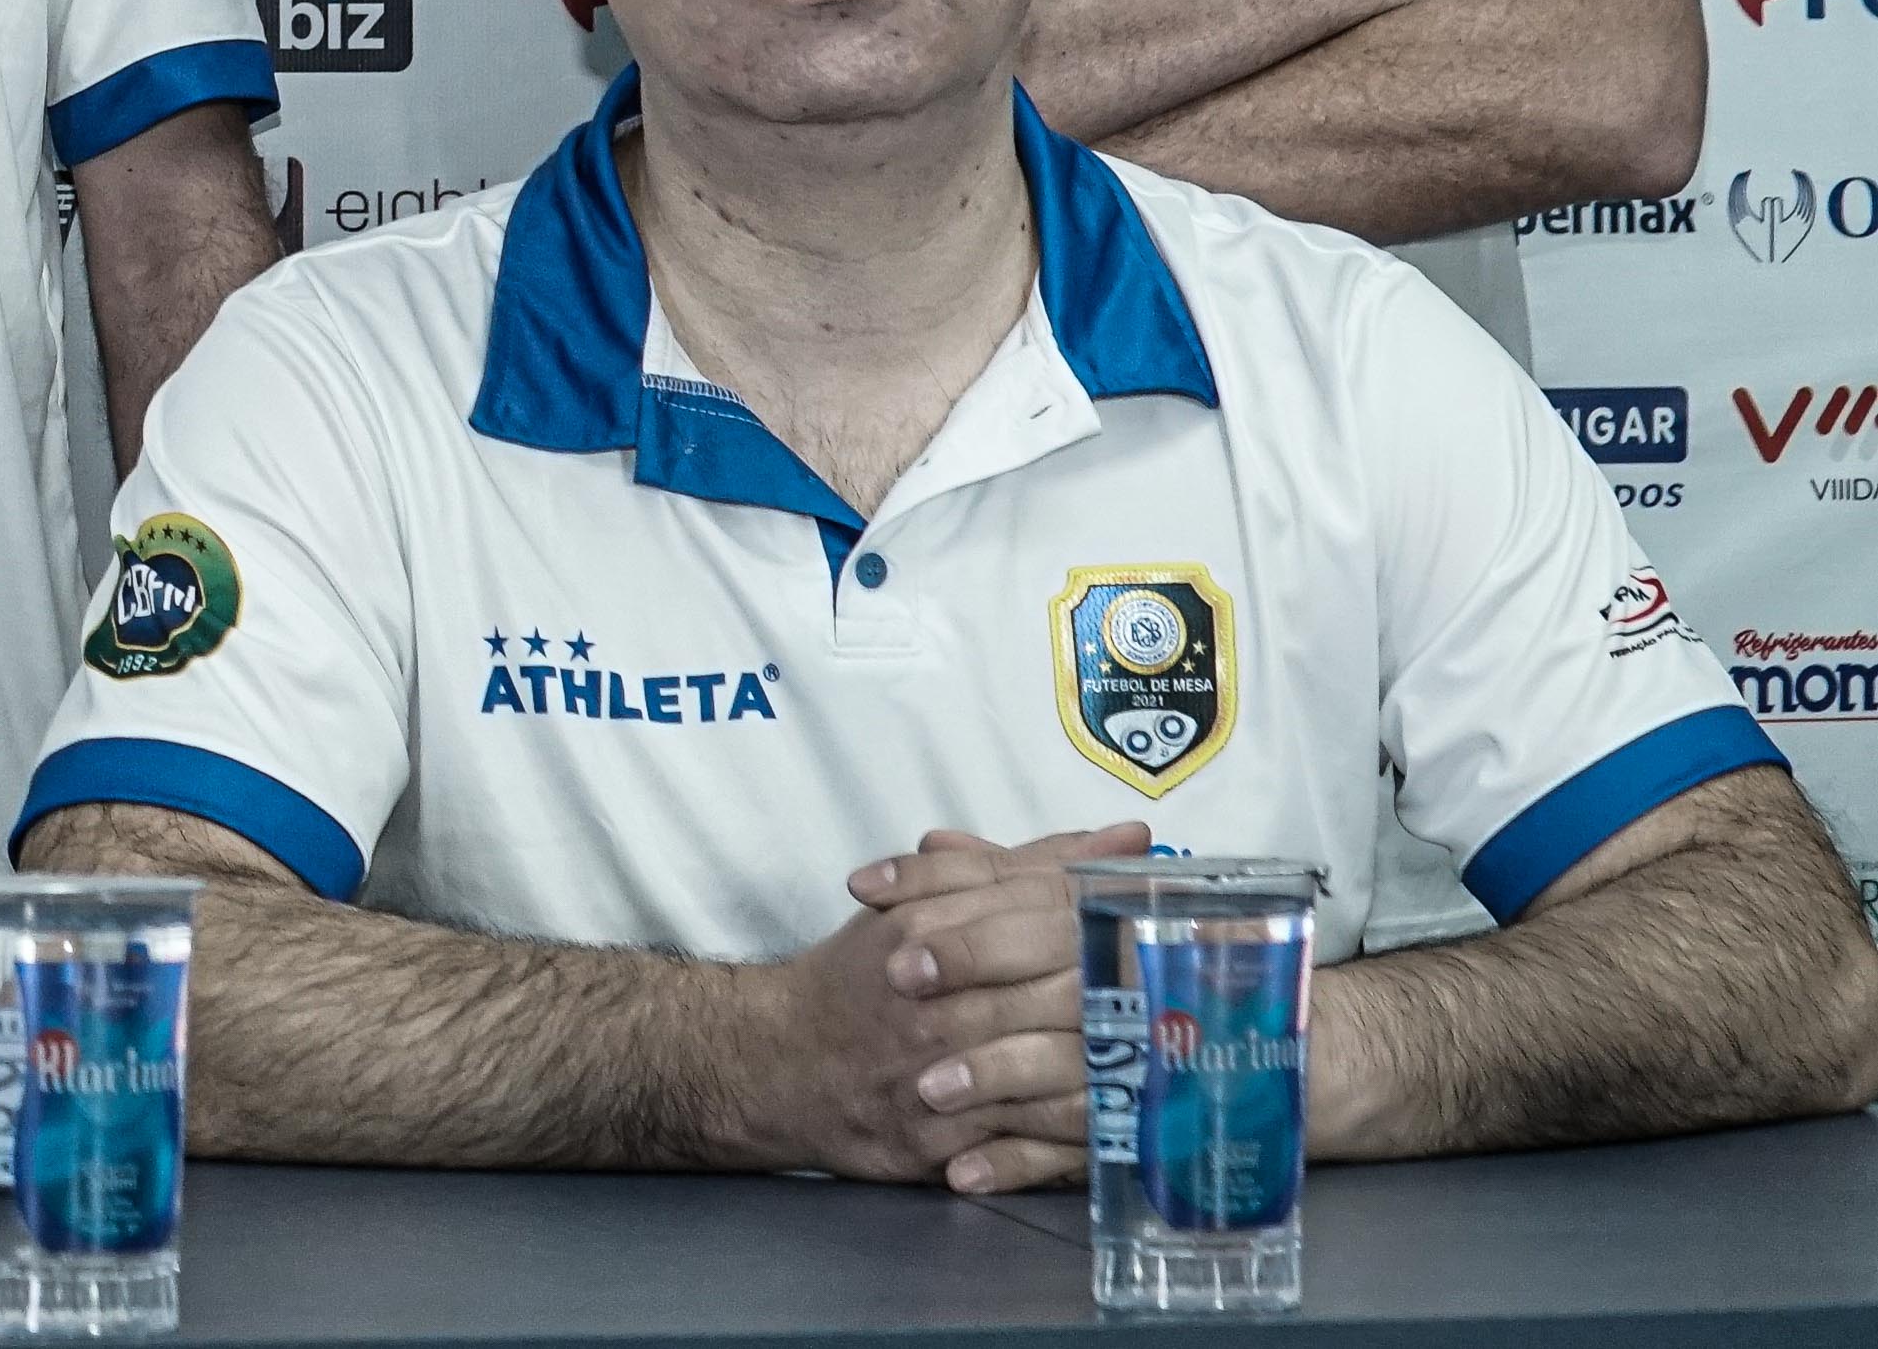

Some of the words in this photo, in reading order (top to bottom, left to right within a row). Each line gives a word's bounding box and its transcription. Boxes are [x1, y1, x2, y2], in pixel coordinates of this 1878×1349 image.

[1082, 678, 1148, 693] FUTEBOL
[1150, 678, 1170, 693] DE
[1173, 678, 1214, 693] MESA
[481, 664, 778, 725] ATHLETA
[1130, 694, 1164, 708] 2021
